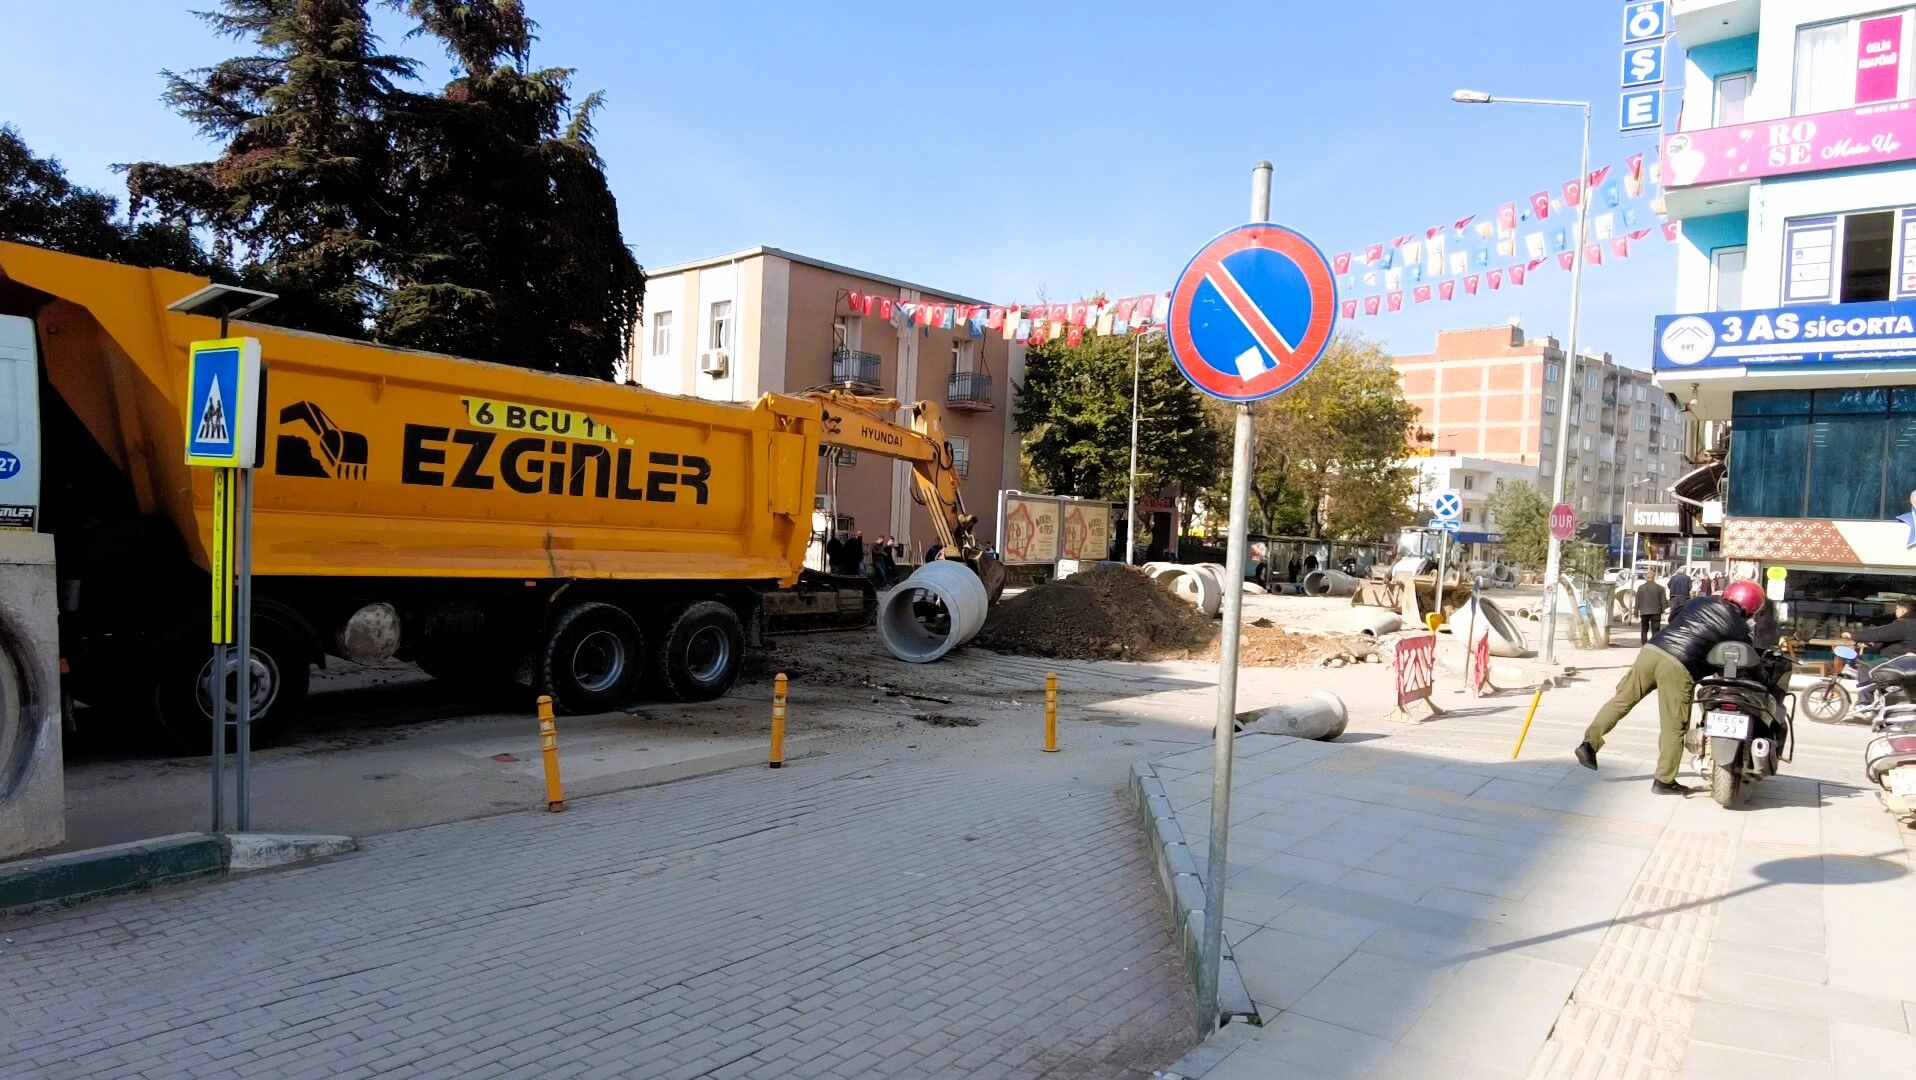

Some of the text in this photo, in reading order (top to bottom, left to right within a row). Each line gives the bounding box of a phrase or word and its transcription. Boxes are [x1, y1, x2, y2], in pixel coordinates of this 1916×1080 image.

[1767, 121, 1817, 146] RO
[1768, 143, 1812, 168] SE
[1721, 316, 1743, 343] 3
[1746, 313, 1800, 342] AS
[506, 405, 571, 434] BCU
[861, 425, 904, 448] HYUNDAI
[1551, 514, 1573, 529] DUR
